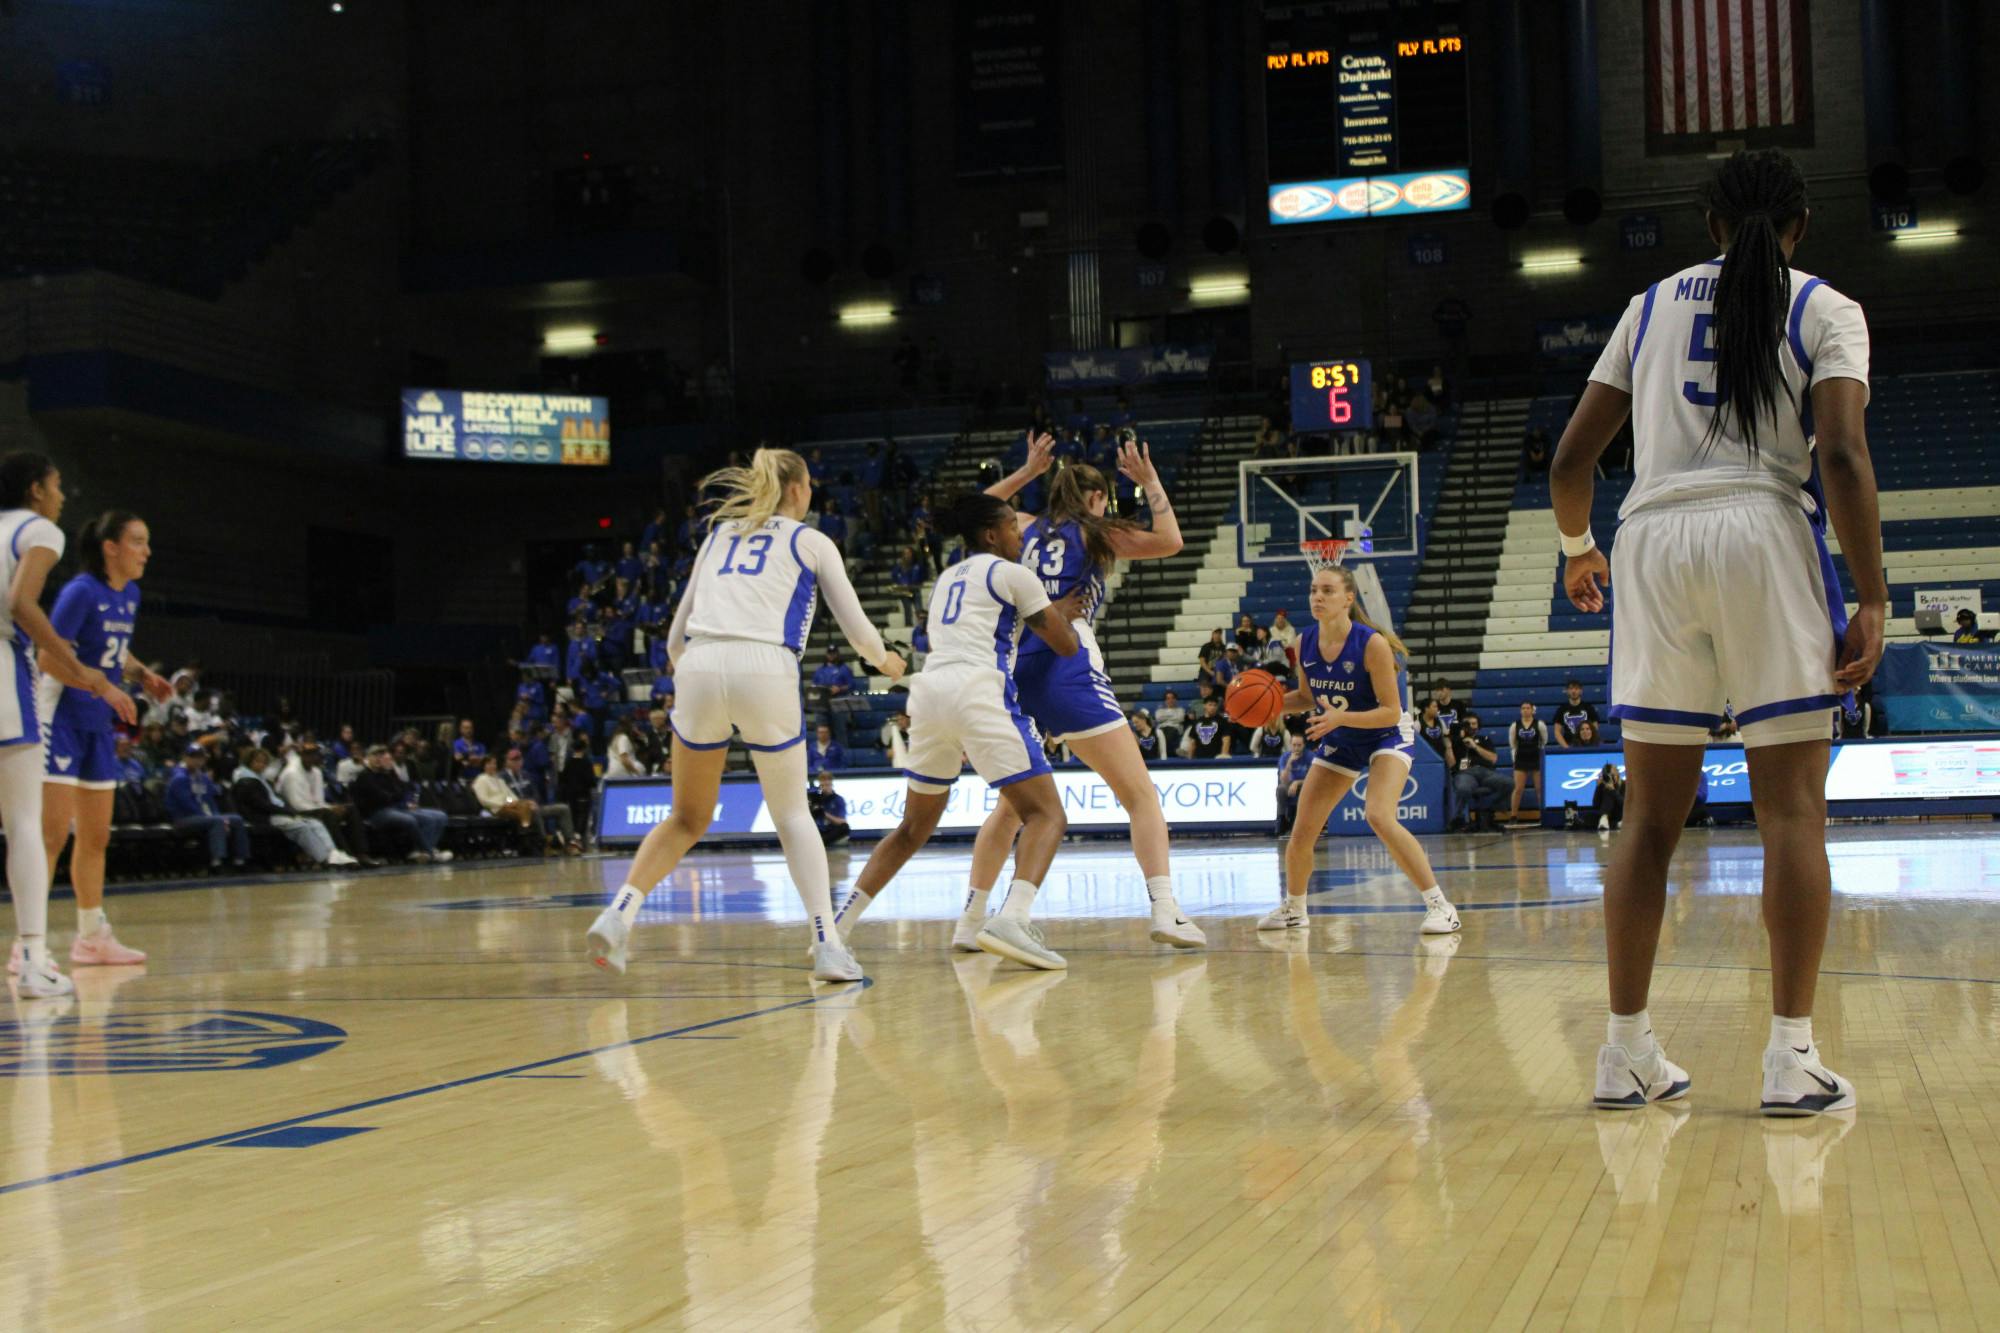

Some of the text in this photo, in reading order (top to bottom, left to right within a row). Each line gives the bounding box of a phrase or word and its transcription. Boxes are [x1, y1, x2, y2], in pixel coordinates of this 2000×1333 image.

[1439, 38, 1462, 52] PTS
[1307, 50, 1330, 65] PTS
[1343, 116, 1388, 128] Insurance
[1880, 212, 1909, 228] 110
[1625, 232, 1656, 248] 109
[1414, 247, 1443, 265] 108
[1311, 363, 1359, 389] 8:57
[462, 391, 592, 413] RECOVER WITH
[1329, 386, 1352, 423] 6
[463, 407, 510, 423] REAL
[406, 415, 455, 434] MILK
[717, 534, 774, 577] 13
[1021, 537, 1066, 577] 43
[941, 580, 967, 626] 0
[1310, 678, 1355, 691] BUFFALO
[1158, 781, 1247, 808] YORK
[626, 804, 673, 824] TASTE
[1343, 805, 1428, 821] HYDAI
